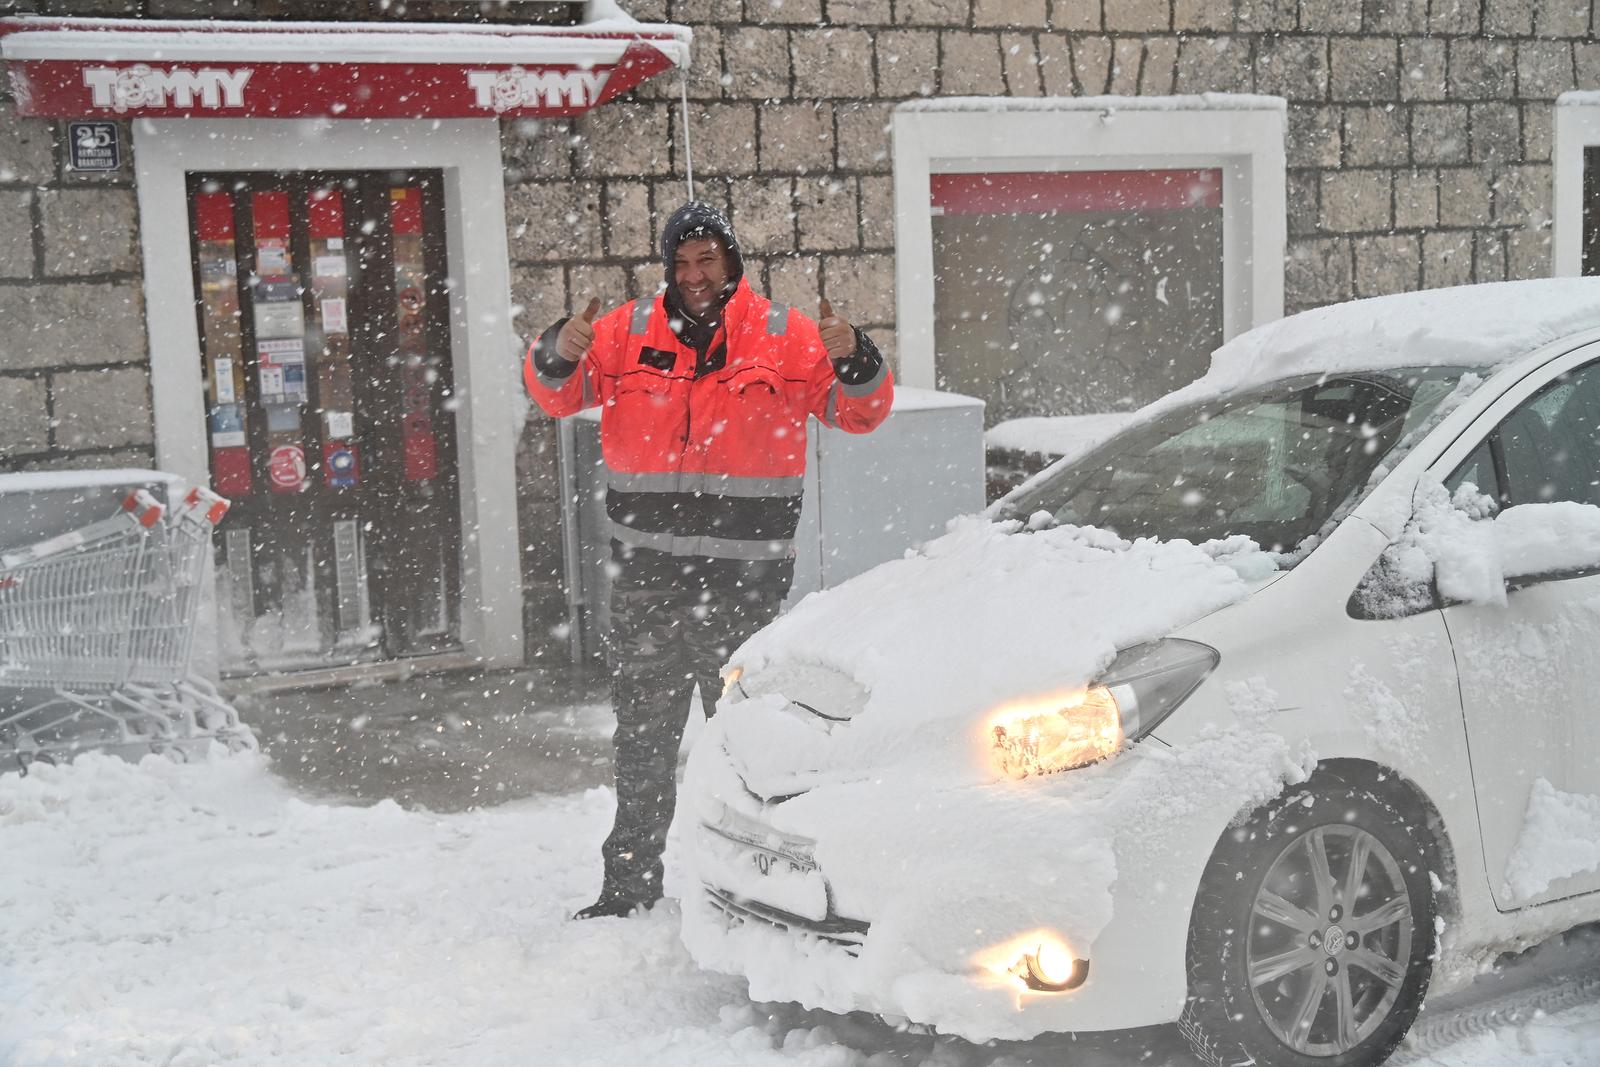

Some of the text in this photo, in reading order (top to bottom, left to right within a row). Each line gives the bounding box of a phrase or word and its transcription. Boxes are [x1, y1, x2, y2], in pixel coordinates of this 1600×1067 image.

[82, 65, 254, 111] TOMMY
[468, 67, 612, 112] TOMMY
[77, 126, 110, 147] 25
